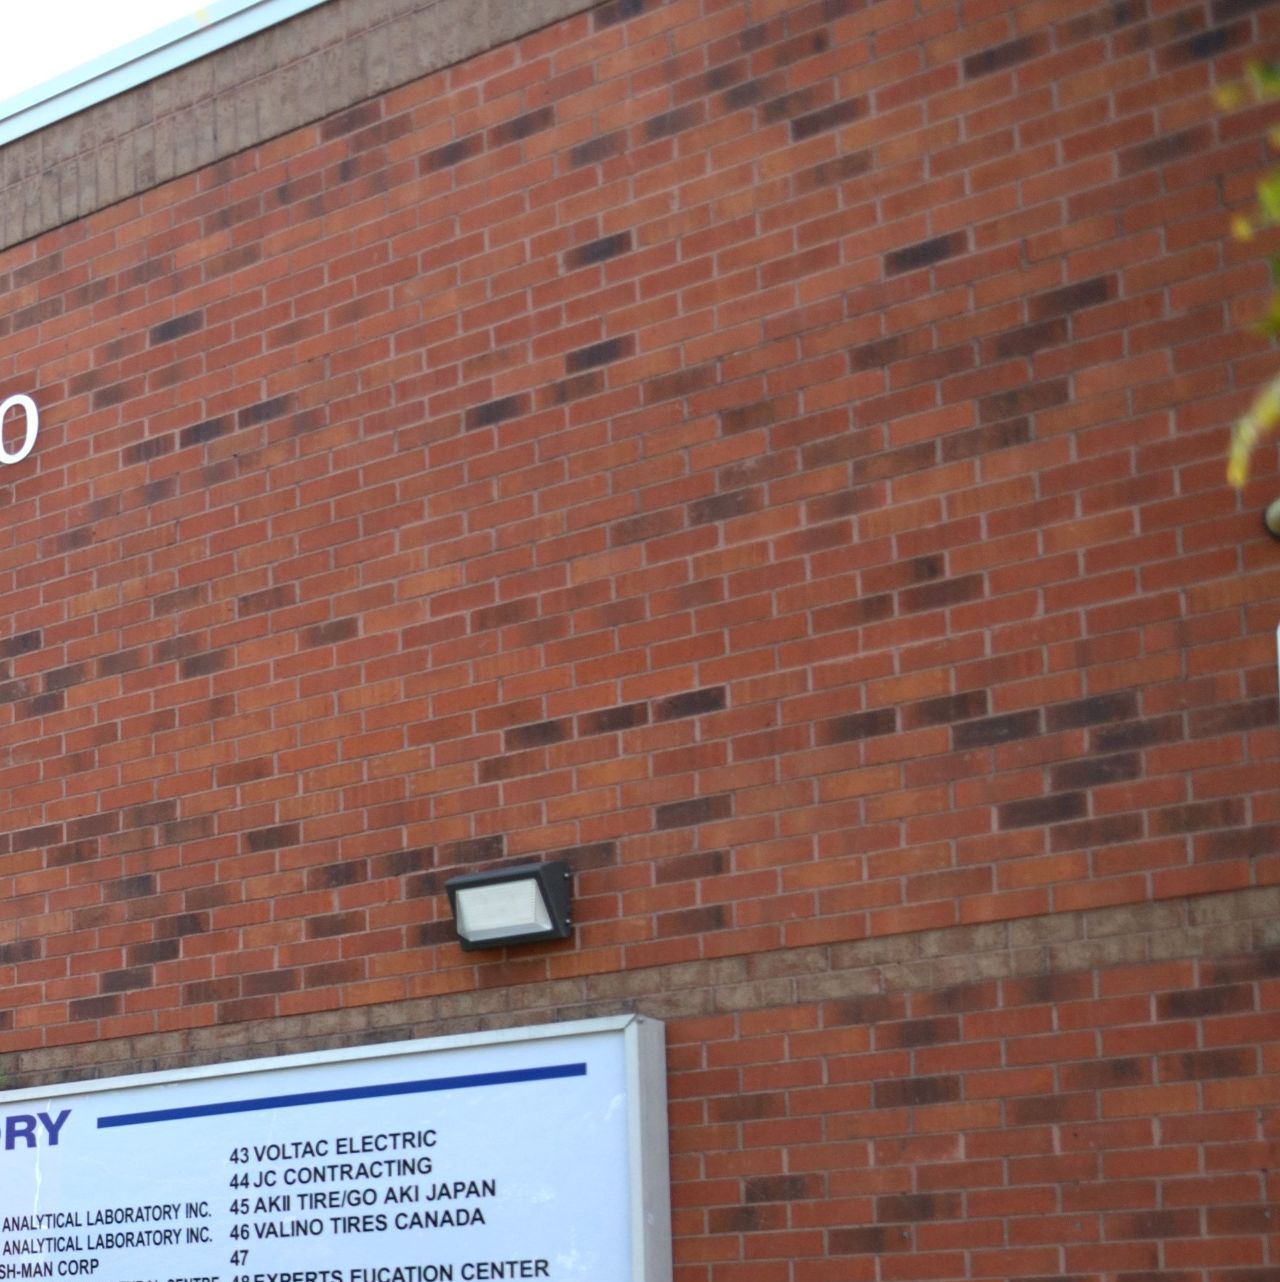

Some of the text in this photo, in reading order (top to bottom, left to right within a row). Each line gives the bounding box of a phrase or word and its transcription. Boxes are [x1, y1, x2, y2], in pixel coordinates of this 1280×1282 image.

[252, 1129, 437, 1162] VOLTAC ELECTRIC
[252, 1157, 432, 1188] JC CONTRACTING
[296, 1188, 377, 1210] TIRE/GO
[383, 1185, 419, 1204] AKI
[425, 1179, 496, 1201] JAPAN
[1, 1212, 83, 1232] ANALYTICAL
[86, 1203, 181, 1226] LABORATORY
[185, 1201, 212, 1218] INC.
[253, 1208, 486, 1239] VALINO TIRES CANADA
[1, 1236, 83, 1255] ANALYTICAL
[86, 1228, 182, 1250] LABORATORY
[185, 1226, 213, 1244] INC.
[57, 1258, 99, 1276] CORP
[229, 1249, 249, 1266] 47
[460, 1259, 550, 1281] CENTER
